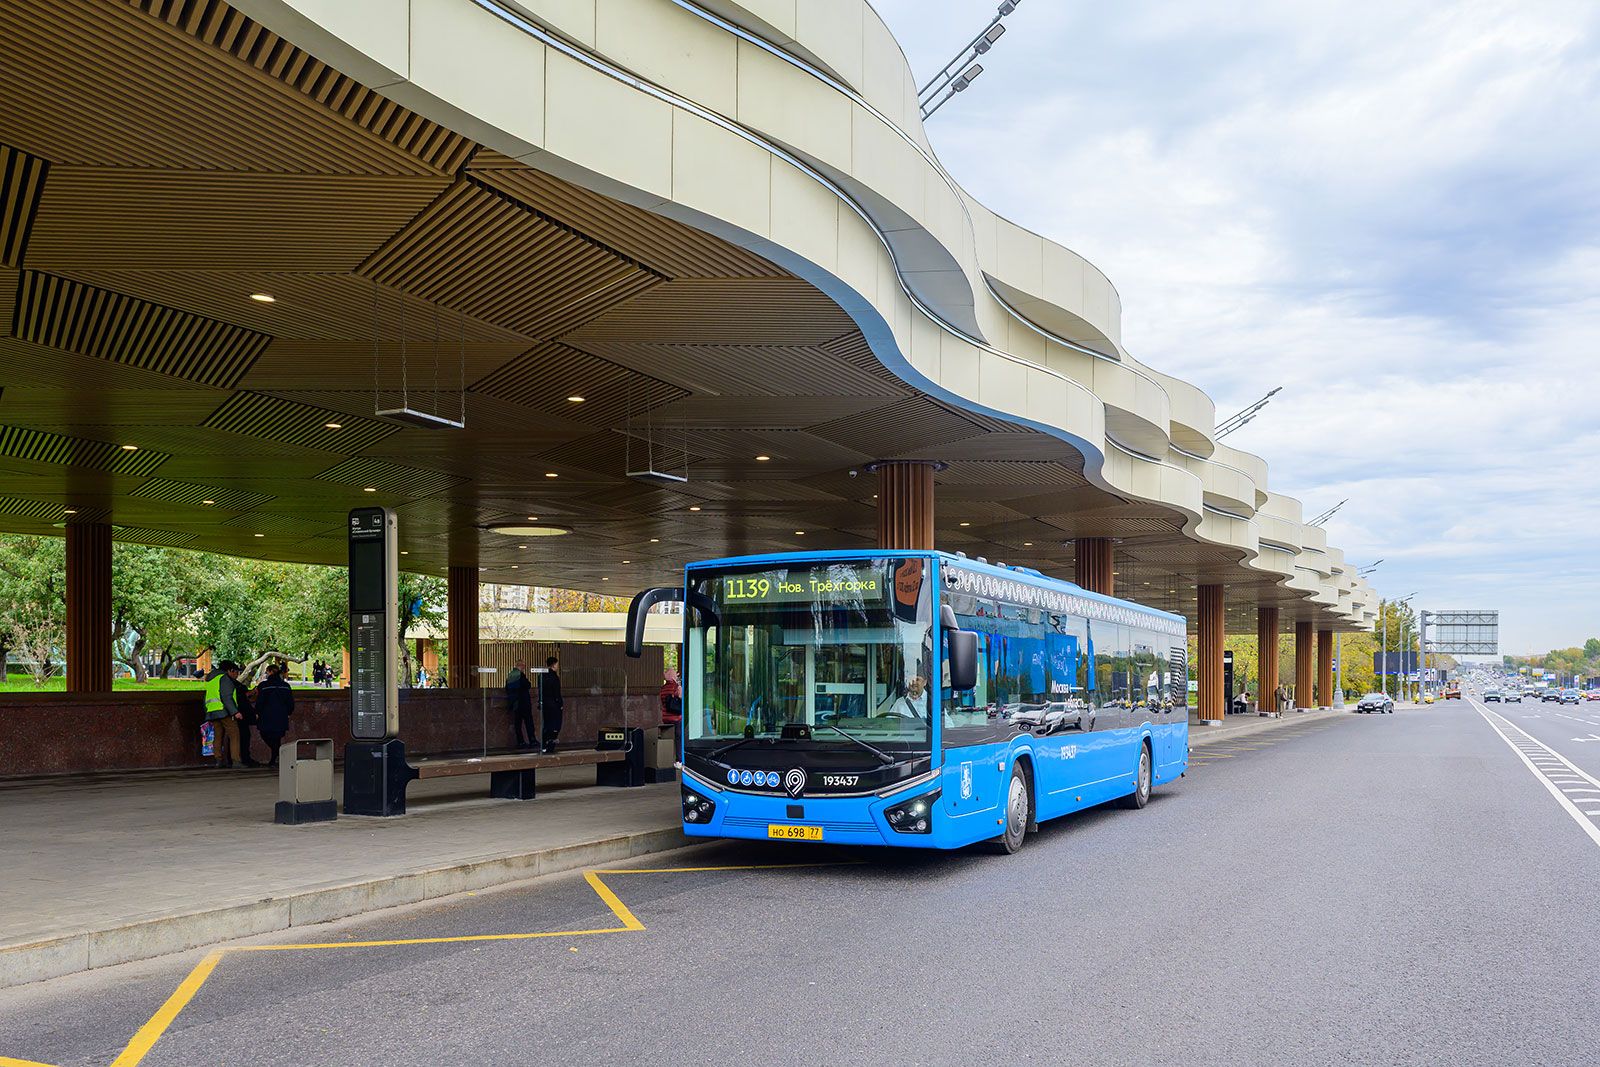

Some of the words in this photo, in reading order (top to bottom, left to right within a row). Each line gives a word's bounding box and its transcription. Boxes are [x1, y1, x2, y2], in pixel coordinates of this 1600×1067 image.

[727, 579, 770, 599] 1139
[778, 582, 805, 593] Нов.
[809, 580, 876, 593] Трёхгорка
[823, 776, 859, 786] 193437
[787, 827, 805, 838] 698
[810, 827, 819, 836] 77
